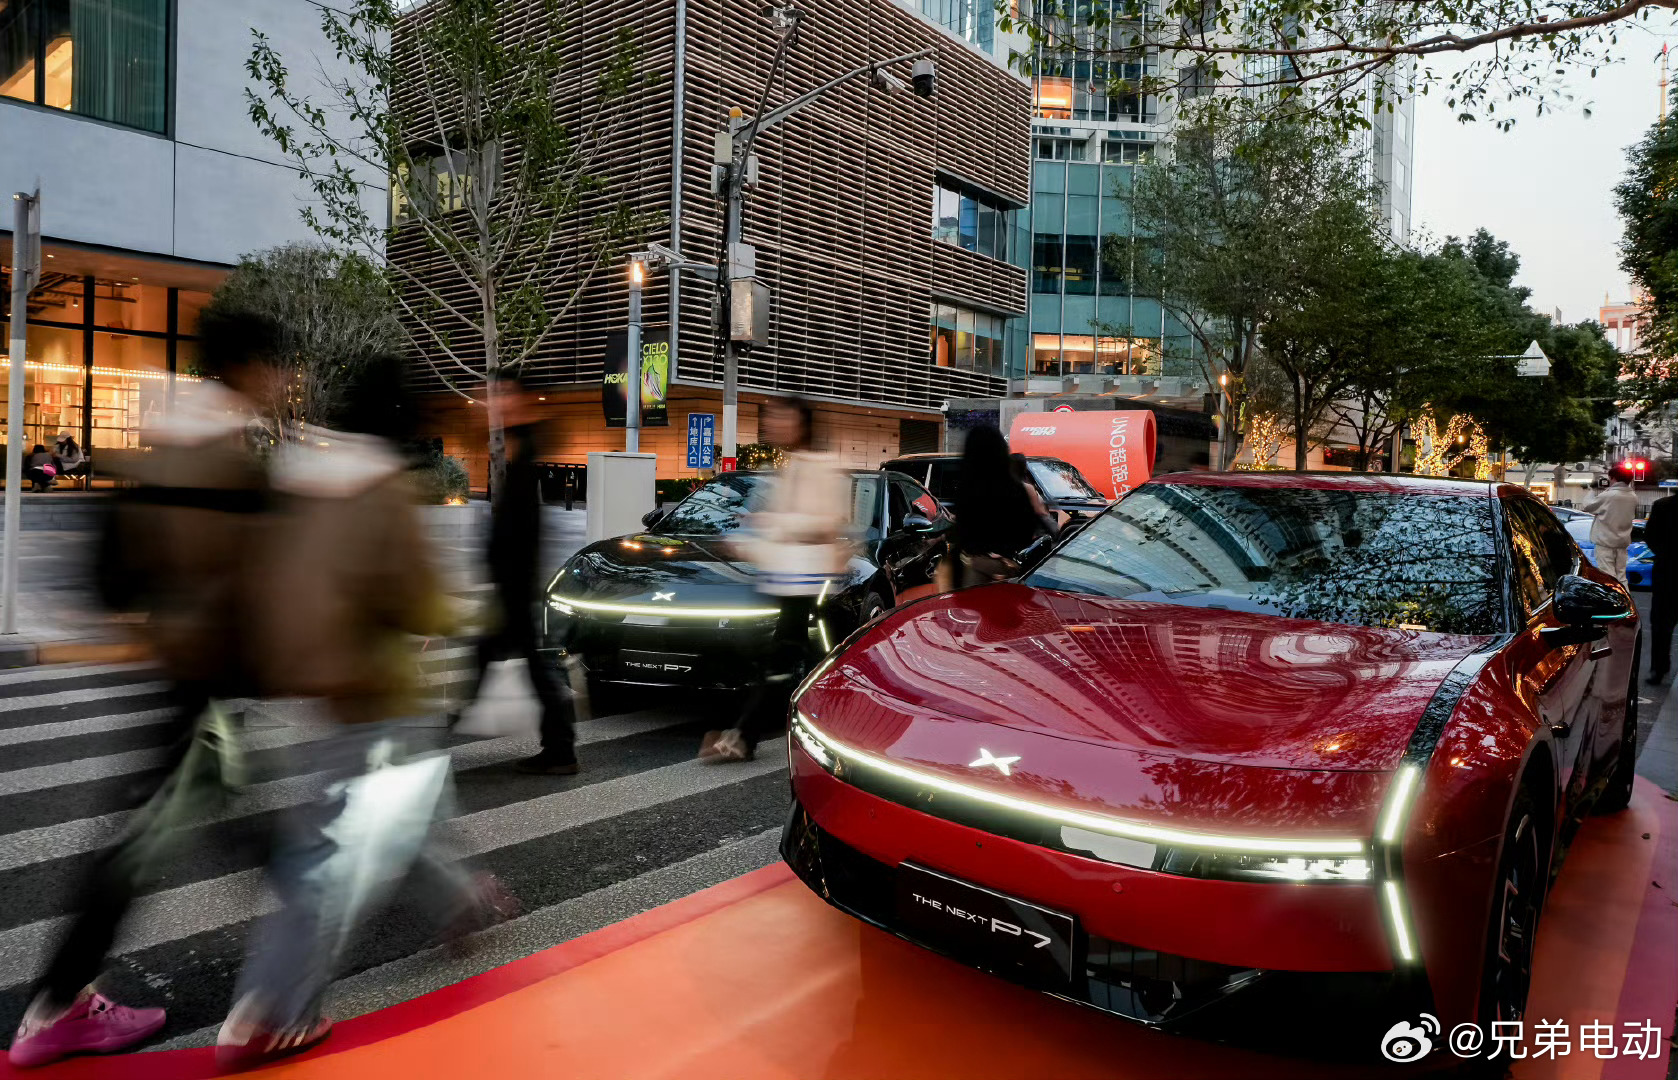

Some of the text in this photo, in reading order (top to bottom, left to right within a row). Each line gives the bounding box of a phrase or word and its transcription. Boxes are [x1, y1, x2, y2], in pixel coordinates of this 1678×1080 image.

[643, 342, 668, 355] CIELO
[689, 426, 699, 465] 地库入口
[702, 427, 712, 465] 嘉里公寓
[664, 663, 692, 673] P7
[912, 893, 1051, 948] THE NEXT P7
